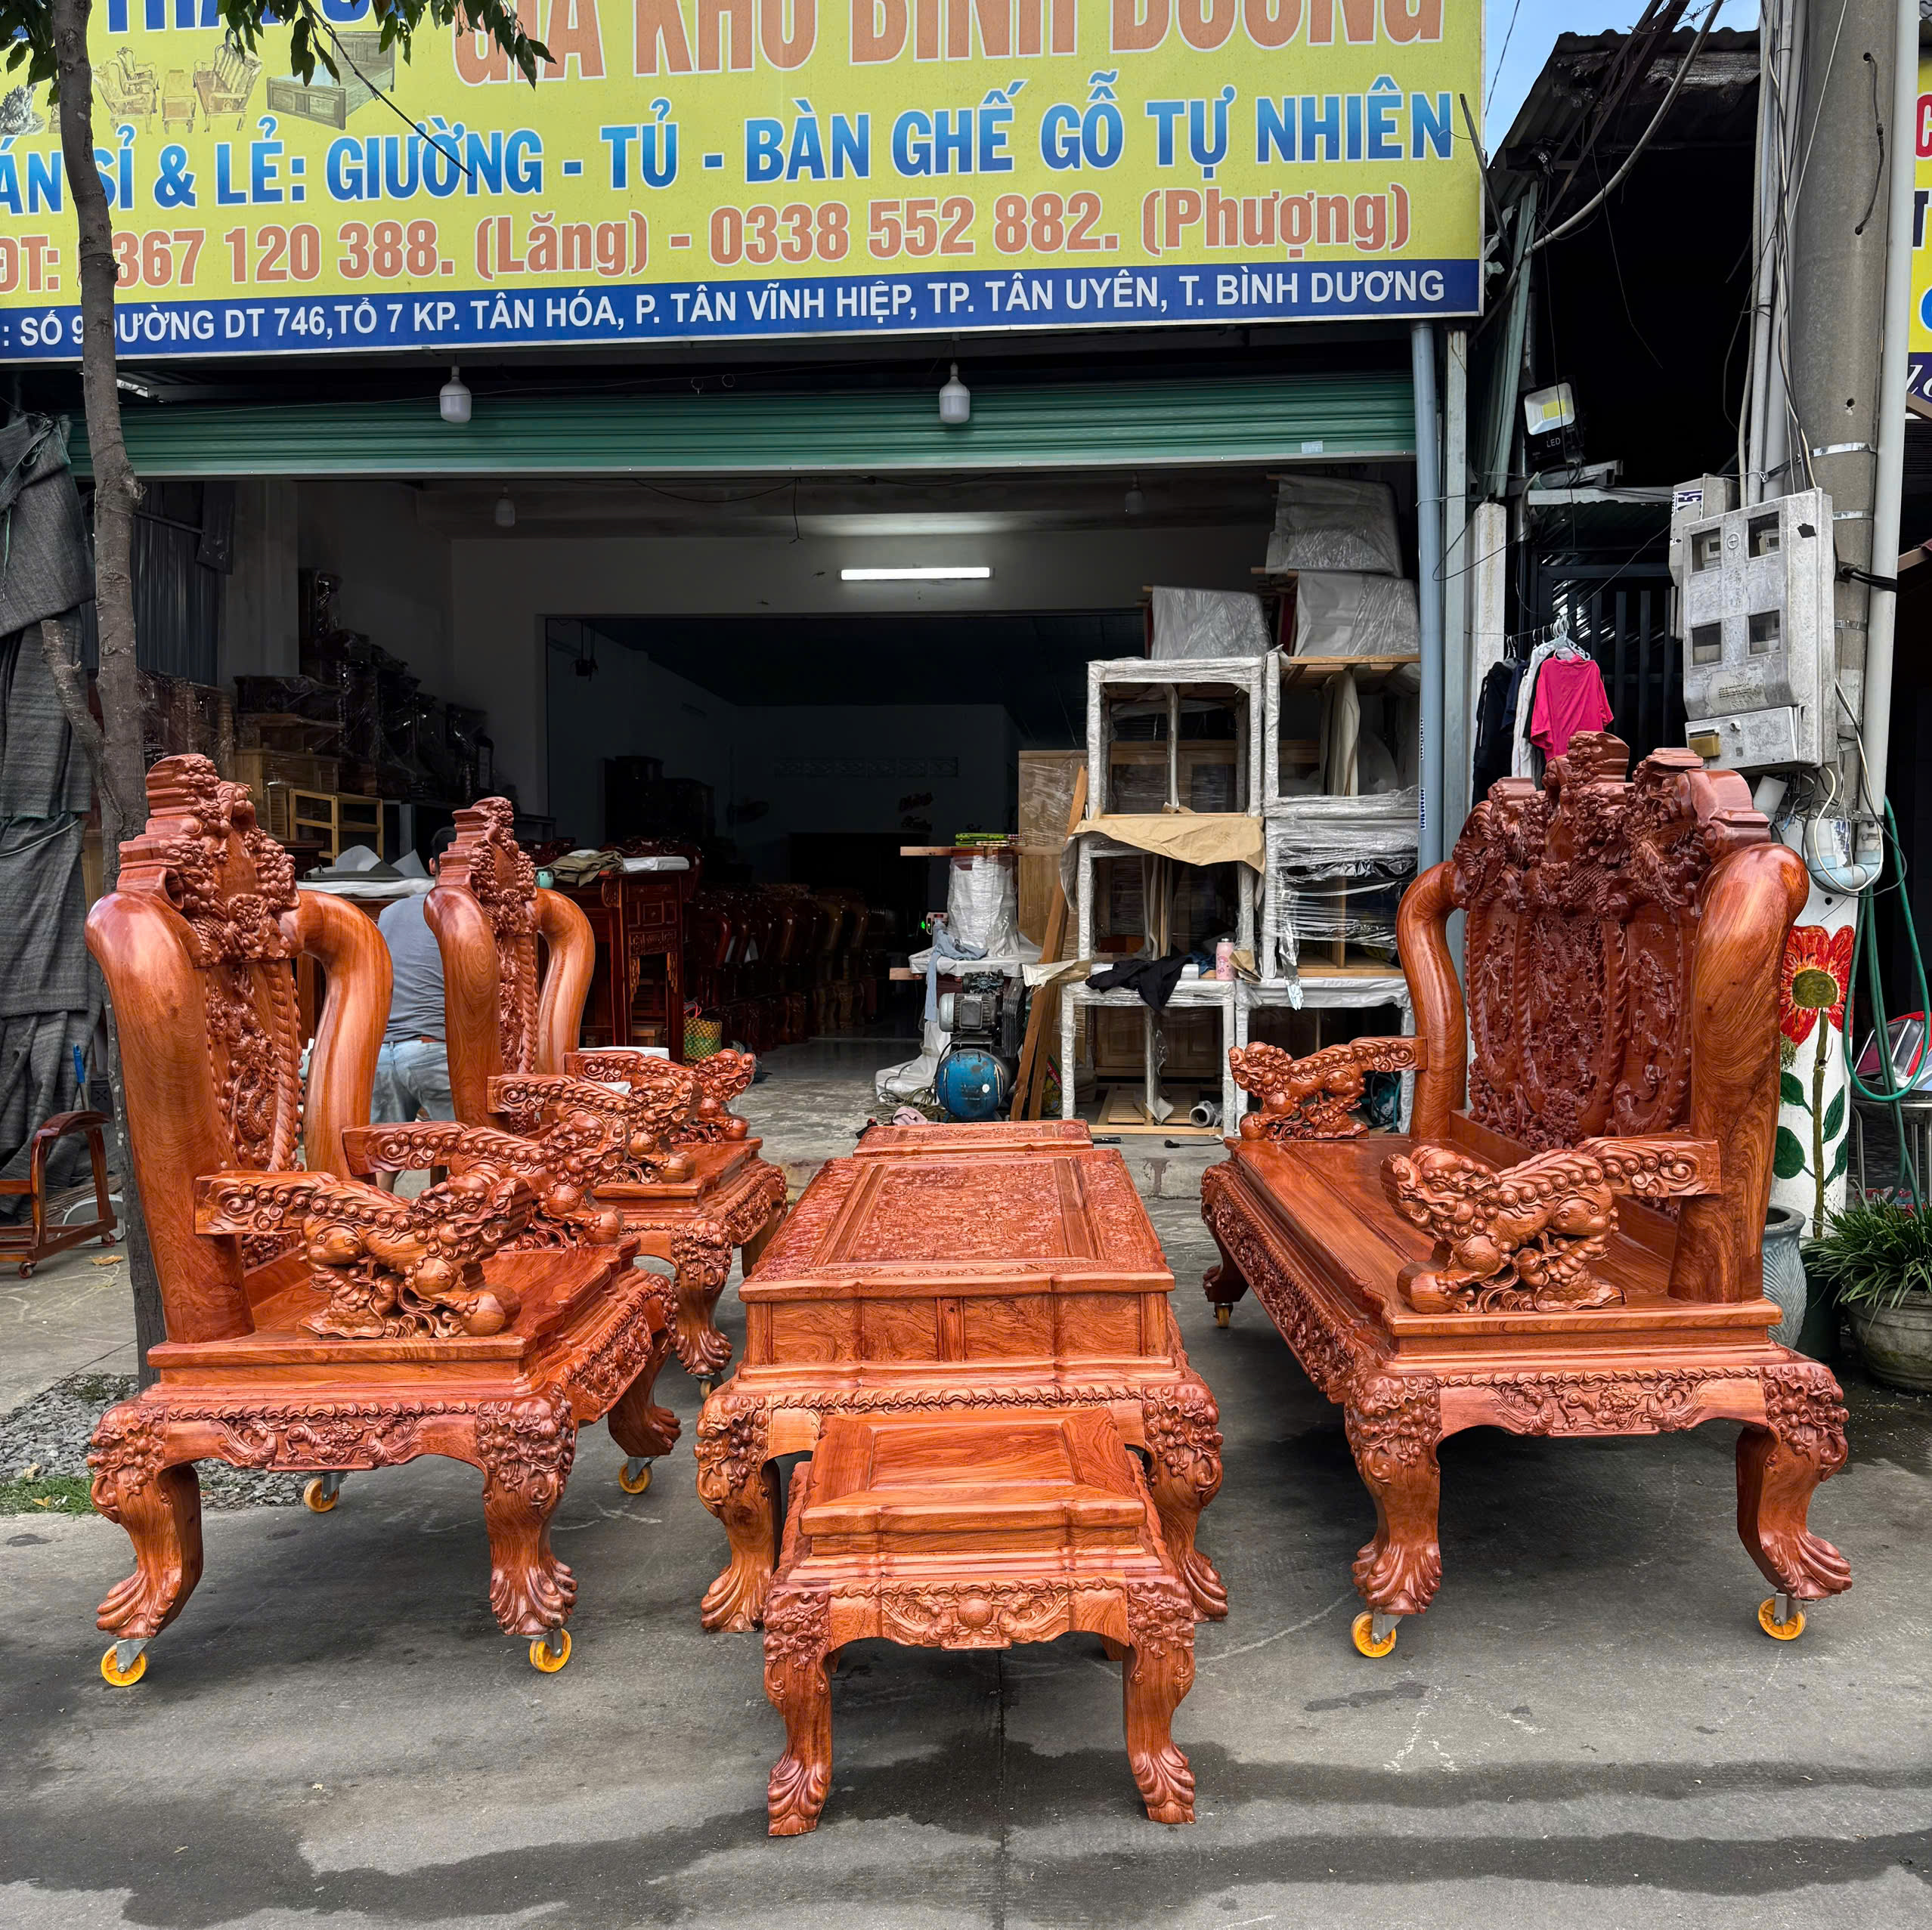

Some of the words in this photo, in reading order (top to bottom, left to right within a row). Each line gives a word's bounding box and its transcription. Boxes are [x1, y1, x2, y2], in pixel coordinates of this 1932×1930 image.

[154, 144, 196, 208] &
[216, 116, 305, 205] LẺ:
[327, 117, 543, 201] GIƯỜNG
[564, 161, 582, 175] -
[600, 99, 679, 189] TỦ
[704, 154, 723, 169] -
[745, 100, 869, 182] BÀN
[892, 79, 1024, 177] GHẾ
[1041, 70, 1124, 170] GỖ
[1146, 87, 1235, 179] TỰ
[1256, 76, 1452, 162] NHIÊN
[78, 230, 205, 287] 367
[225, 224, 320, 283] 120
[339, 221, 453, 279] 388.
[477, 212, 647, 280] (Lăng)
[670, 235, 691, 248] -
[711, 203, 848, 264] 0338
[869, 198, 974, 258] 552
[995, 193, 1118, 252] 882.
[1144, 184, 1409, 258] (Phượng)
[20, 309, 63, 346] SỐ
[115, 305, 215, 342] ƯỜNG
[225, 307, 265, 339] DT
[386, 304, 403, 332] 7
[414, 302, 460, 332] KP.
[470, 292, 534, 330] TÂN
[546, 289, 624, 331] HÓA,
[636, 295, 660, 325] P.
[670, 284, 736, 323] TÂN
[748, 282, 824, 321] VĨNH
[837, 280, 917, 323] HIỆP,
[927, 282, 974, 314] TP.
[985, 271, 1053, 312] TÂN
[1065, 268, 1167, 313] UYÊN,
[1178, 274, 1205, 307] T.
[1217, 265, 1298, 306] BÌNH
[1311, 270, 1444, 304] DƯƠNG
[1547, 437, 1561, 448] LED
